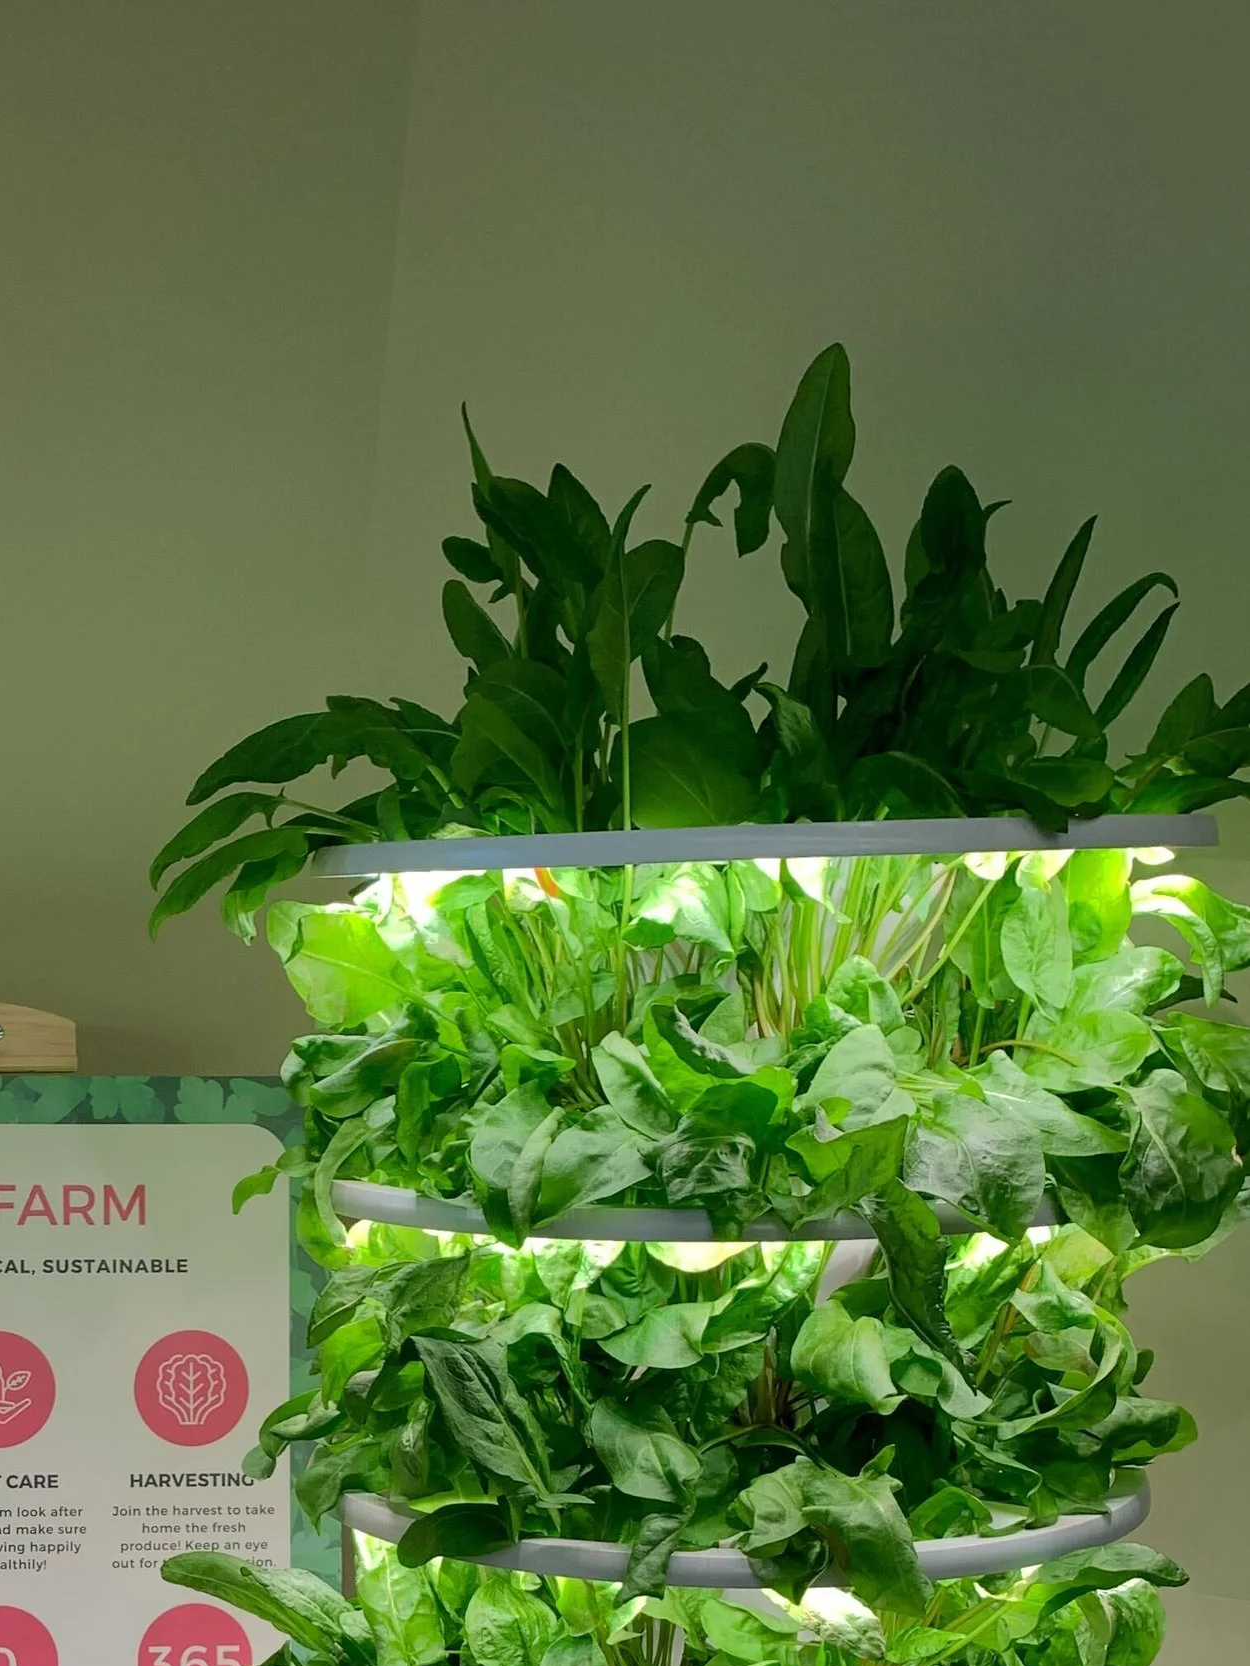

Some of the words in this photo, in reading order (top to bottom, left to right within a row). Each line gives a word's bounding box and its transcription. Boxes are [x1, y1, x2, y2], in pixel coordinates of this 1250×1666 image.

[42, 1259, 188, 1274] SUSTAINABLE
[6, 1474, 58, 1489] CARE
[17, 1507, 46, 1517] look
[51, 1506, 83, 1517] after
[112, 1506, 141, 1517] Join
[146, 1505, 168, 1516] the
[173, 1505, 222, 1516] harvest
[228, 1505, 241, 1515] to
[246, 1504, 275, 1515] take
[16, 1524, 53, 1535] make
[58, 1525, 87, 1534] sure
[142, 1523, 181, 1533] home
[186, 1523, 208, 1533] the
[213, 1522, 246, 1533] fresh
[30, 1541, 82, 1555] happily
[121, 1540, 181, 1553] produce!
[186, 1540, 219, 1552] Keep
[224, 1541, 240, 1550] an
[245, 1540, 268, 1552] eye
[112, 1559, 134, 1569] out
[140, 1558, 157, 1568] for
